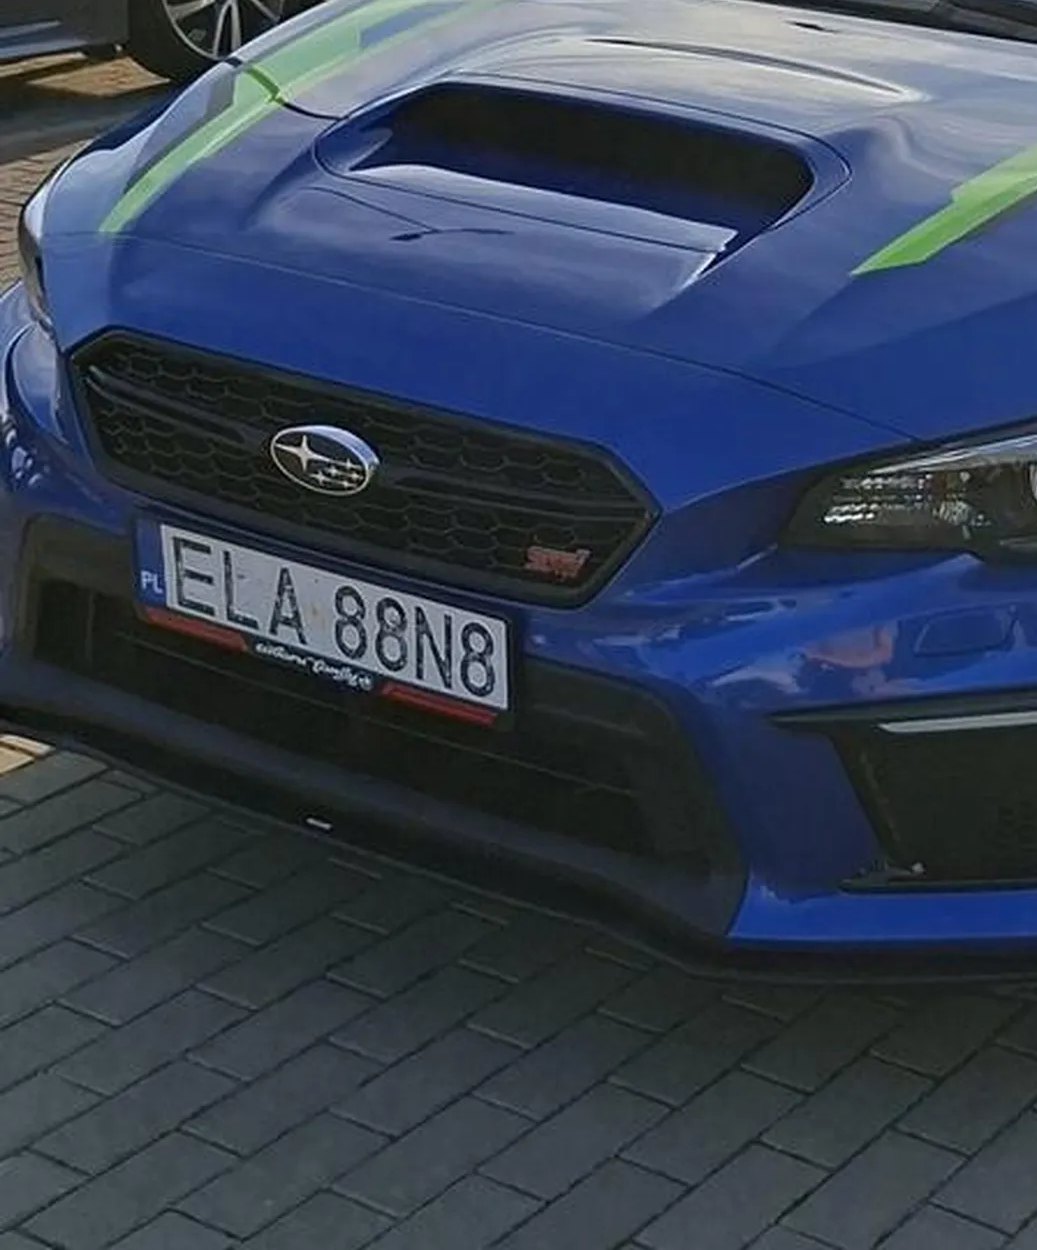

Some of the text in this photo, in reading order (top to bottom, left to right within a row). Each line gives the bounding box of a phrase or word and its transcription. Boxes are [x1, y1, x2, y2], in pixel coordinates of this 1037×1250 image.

[140, 570, 163, 594] PL
[172, 536, 308, 646] ELA
[333, 585, 497, 698] 88N8
